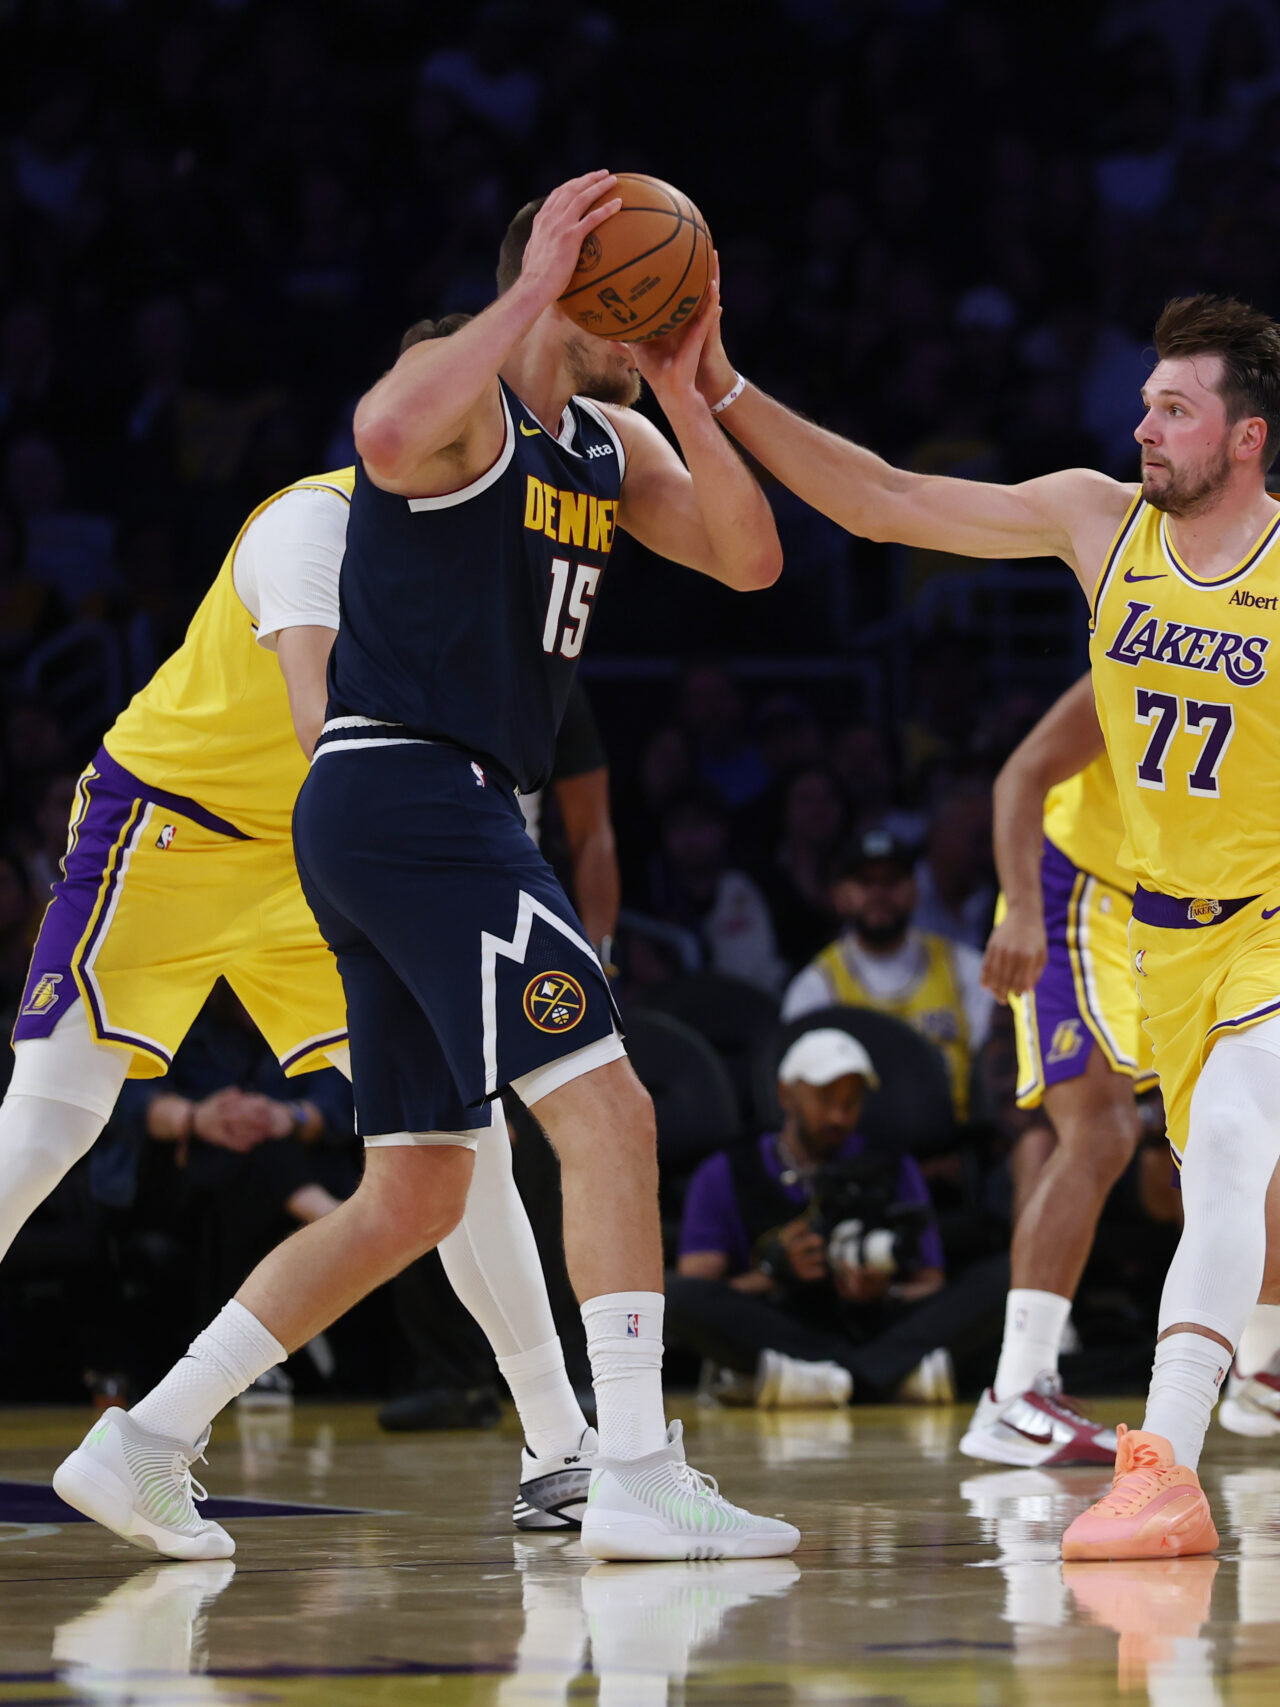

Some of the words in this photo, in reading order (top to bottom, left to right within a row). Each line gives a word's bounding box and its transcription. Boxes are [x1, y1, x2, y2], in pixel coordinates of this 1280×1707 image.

[523, 474, 620, 554] DENVE
[542, 556, 602, 661] 15
[1105, 600, 1272, 689] LAKERS
[1228, 590, 1279, 611] Albert
[1134, 686, 1236, 799] 77
